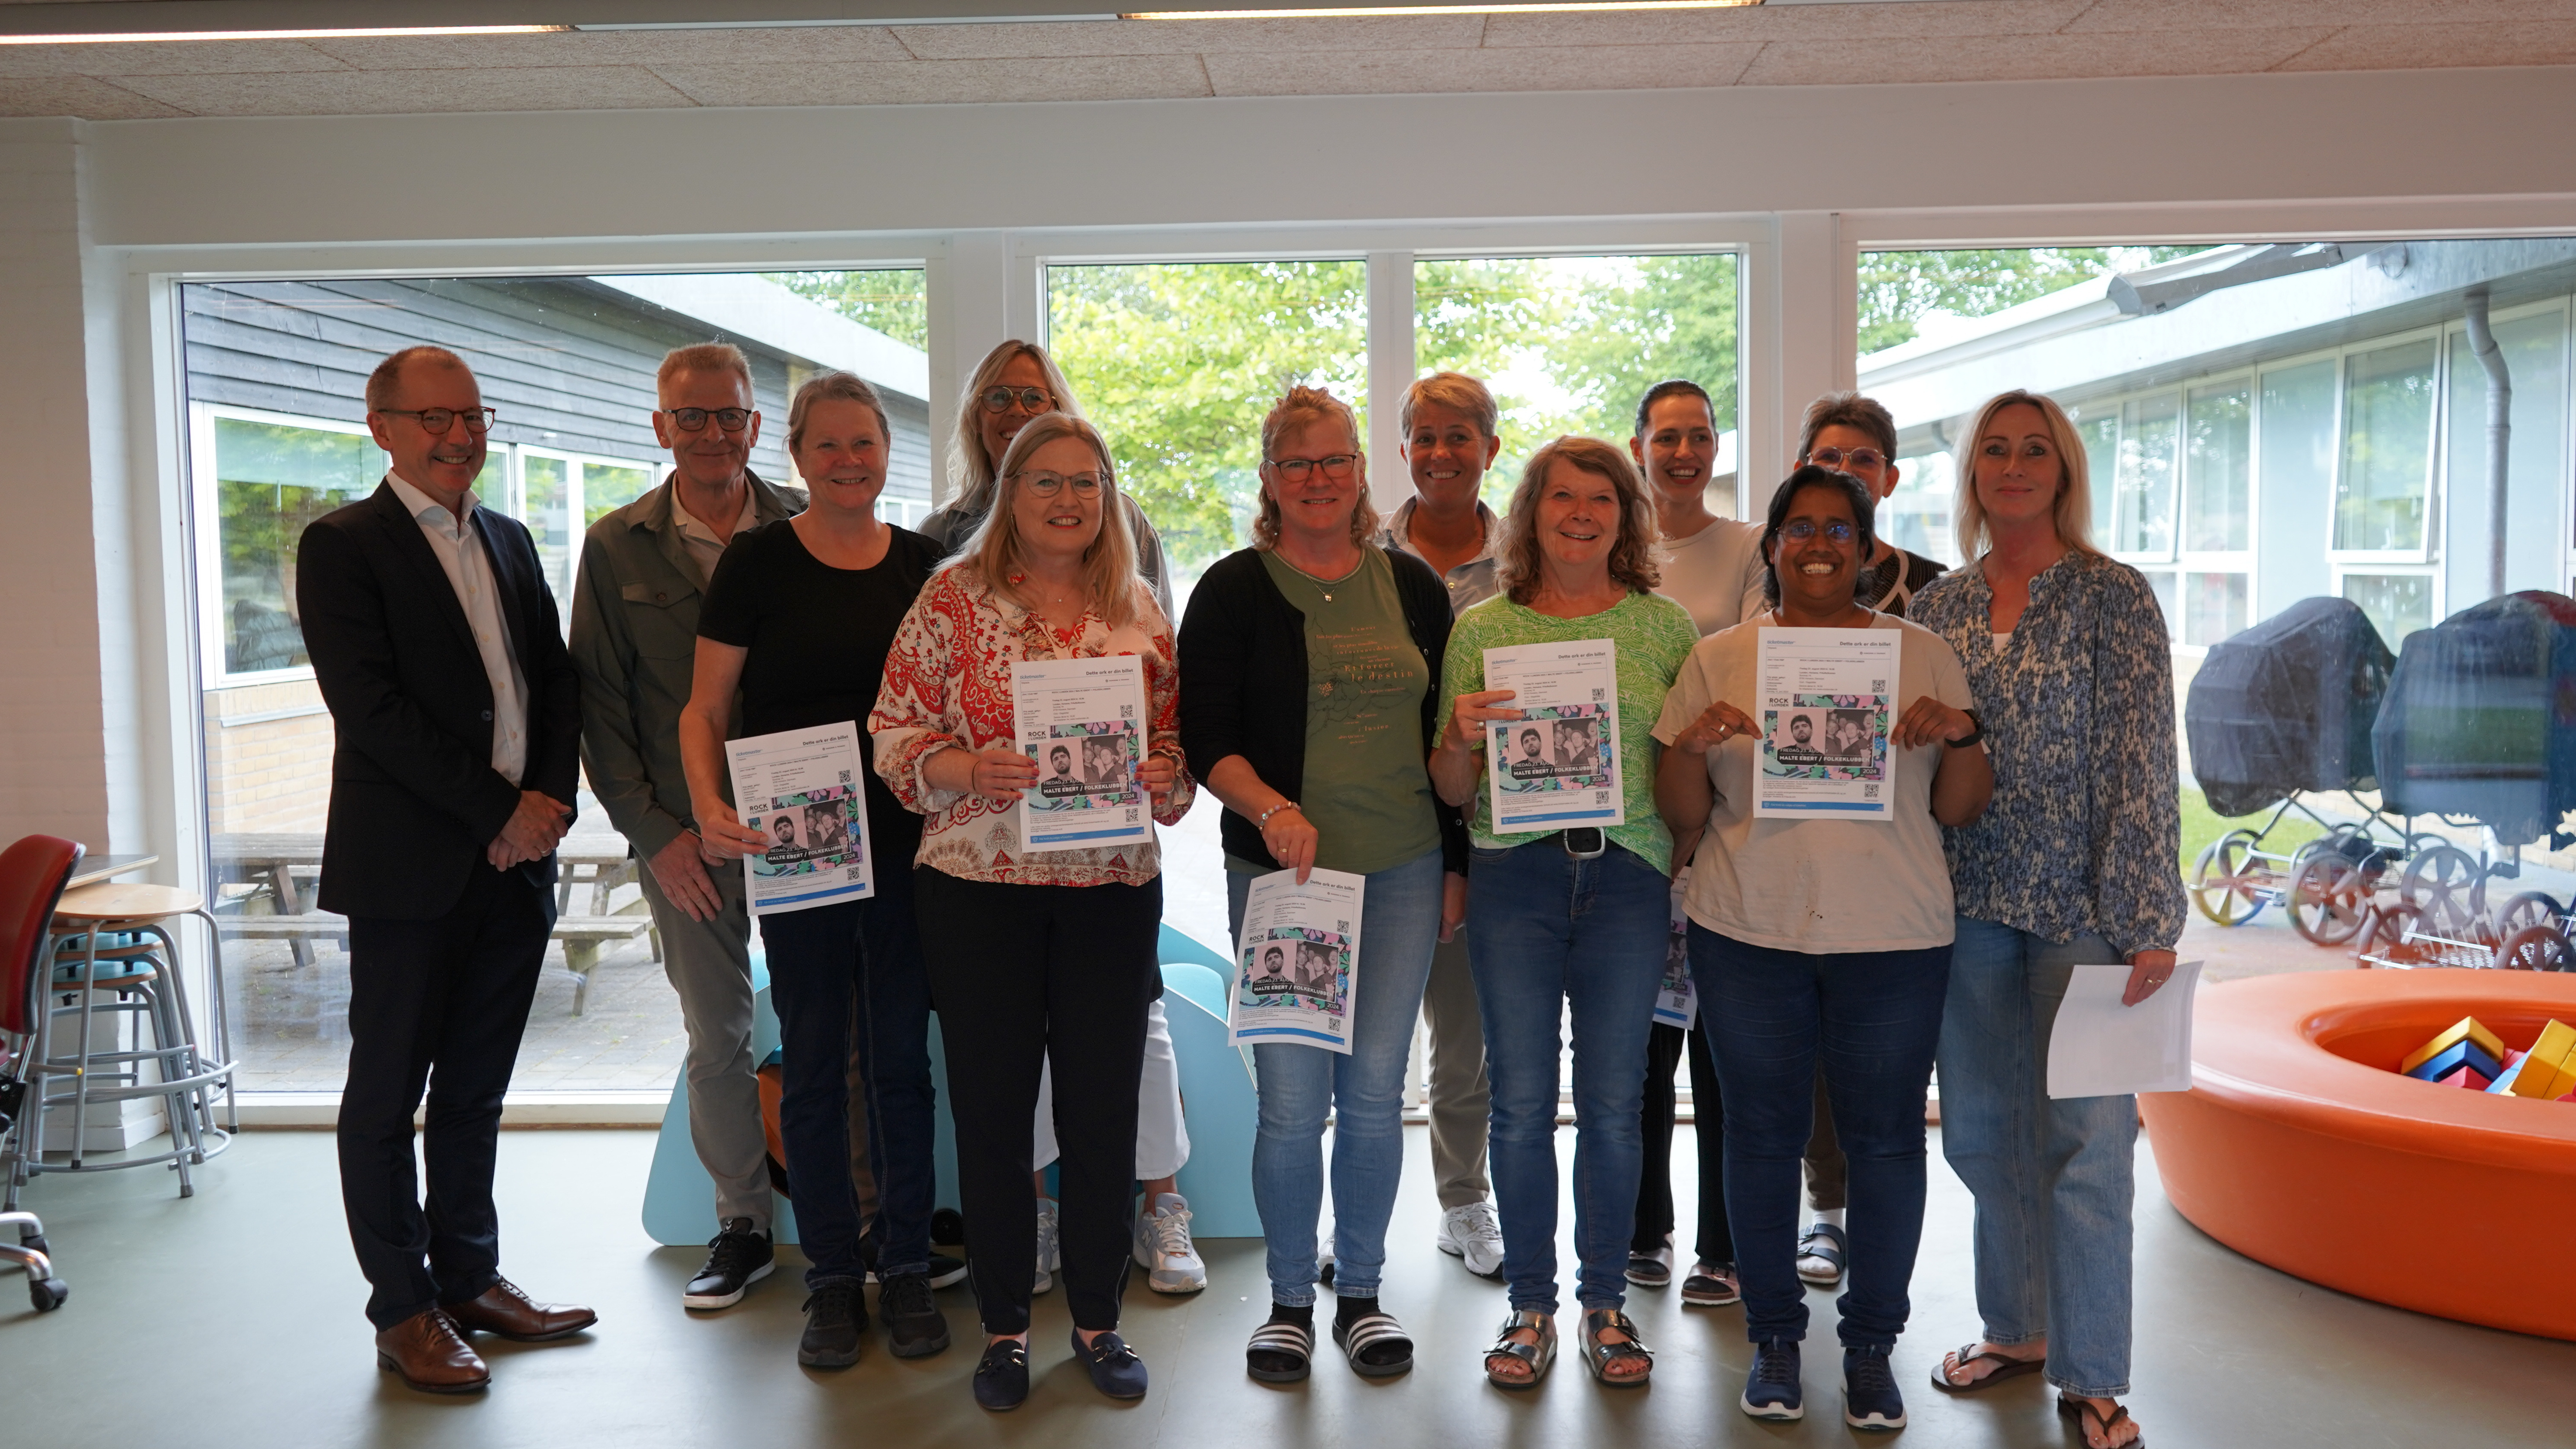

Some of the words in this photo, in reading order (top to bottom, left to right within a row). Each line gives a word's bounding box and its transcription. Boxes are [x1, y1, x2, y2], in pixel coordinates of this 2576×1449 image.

[1352, 673, 1364, 682] le
[1369, 670, 1413, 681] destin
[1084, 782, 1127, 791] FOLKEKLUBBEN
[808, 844, 848, 856] FOLKEKLUBBEN
[1294, 985, 1334, 996] FOLKEKLUBBEN
